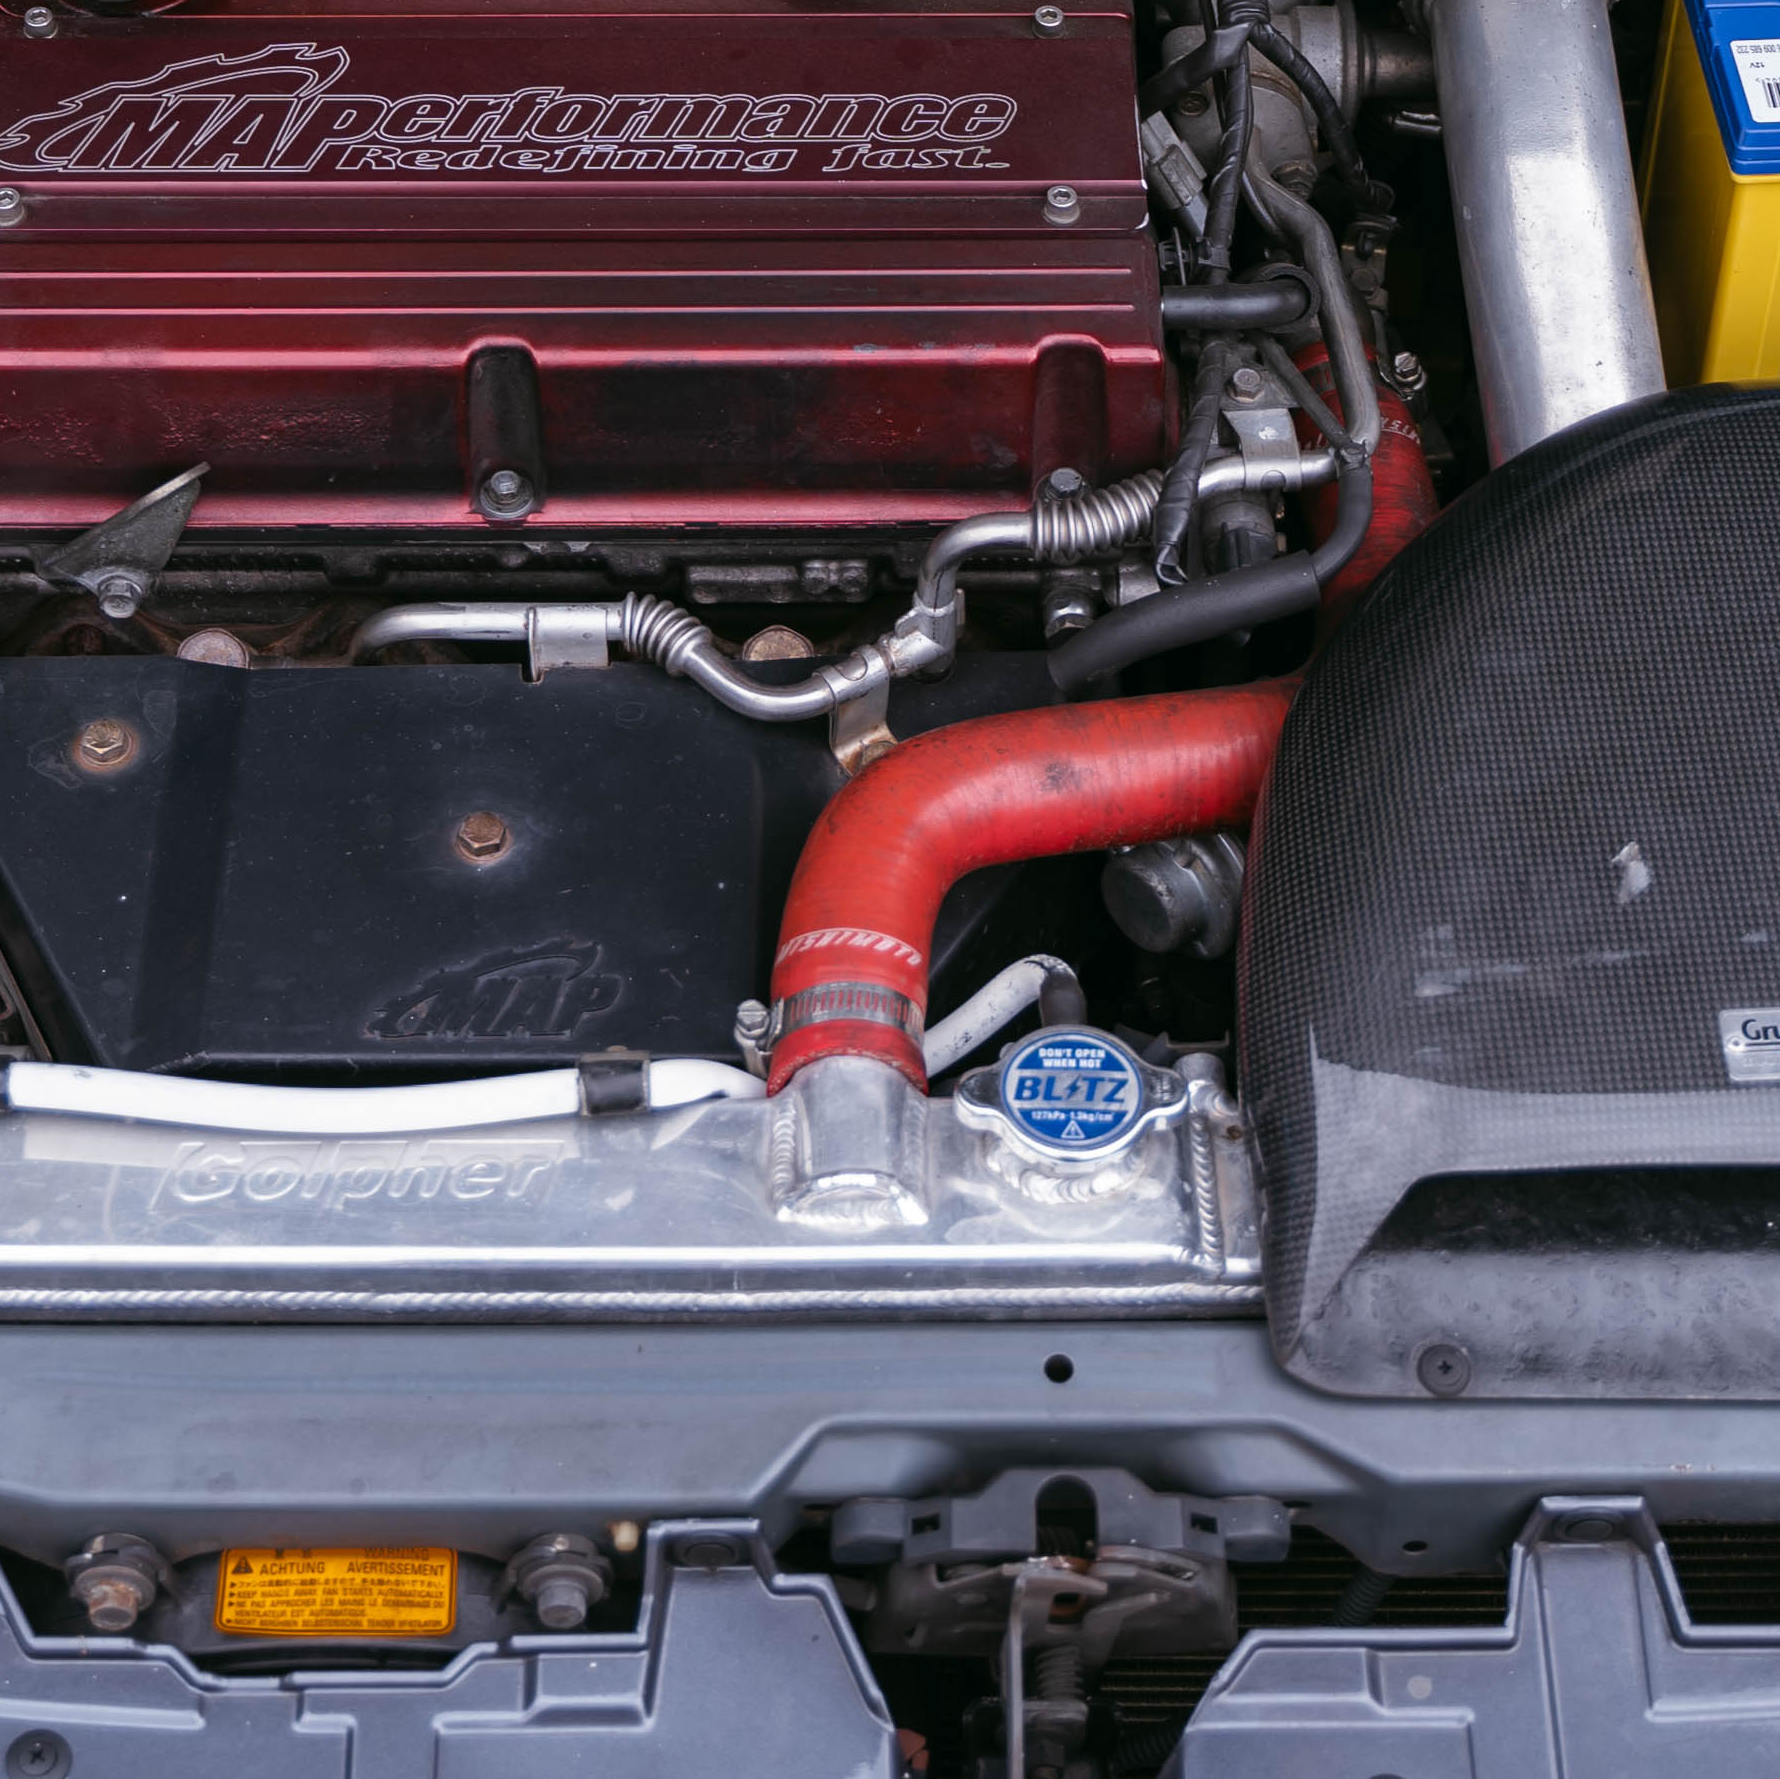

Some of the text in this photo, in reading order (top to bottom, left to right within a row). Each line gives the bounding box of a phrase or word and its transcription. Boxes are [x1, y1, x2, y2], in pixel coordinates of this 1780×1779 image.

[335, 143, 1011, 173] Redefining fast.
[1038, 1047, 1106, 1058] DON'T OPEN
[1042, 1058, 1102, 1068] WHEN HOT
[259, 1561, 326, 1576] ACHTUNG
[347, 1561, 446, 1577] AVERTISSEMENT
